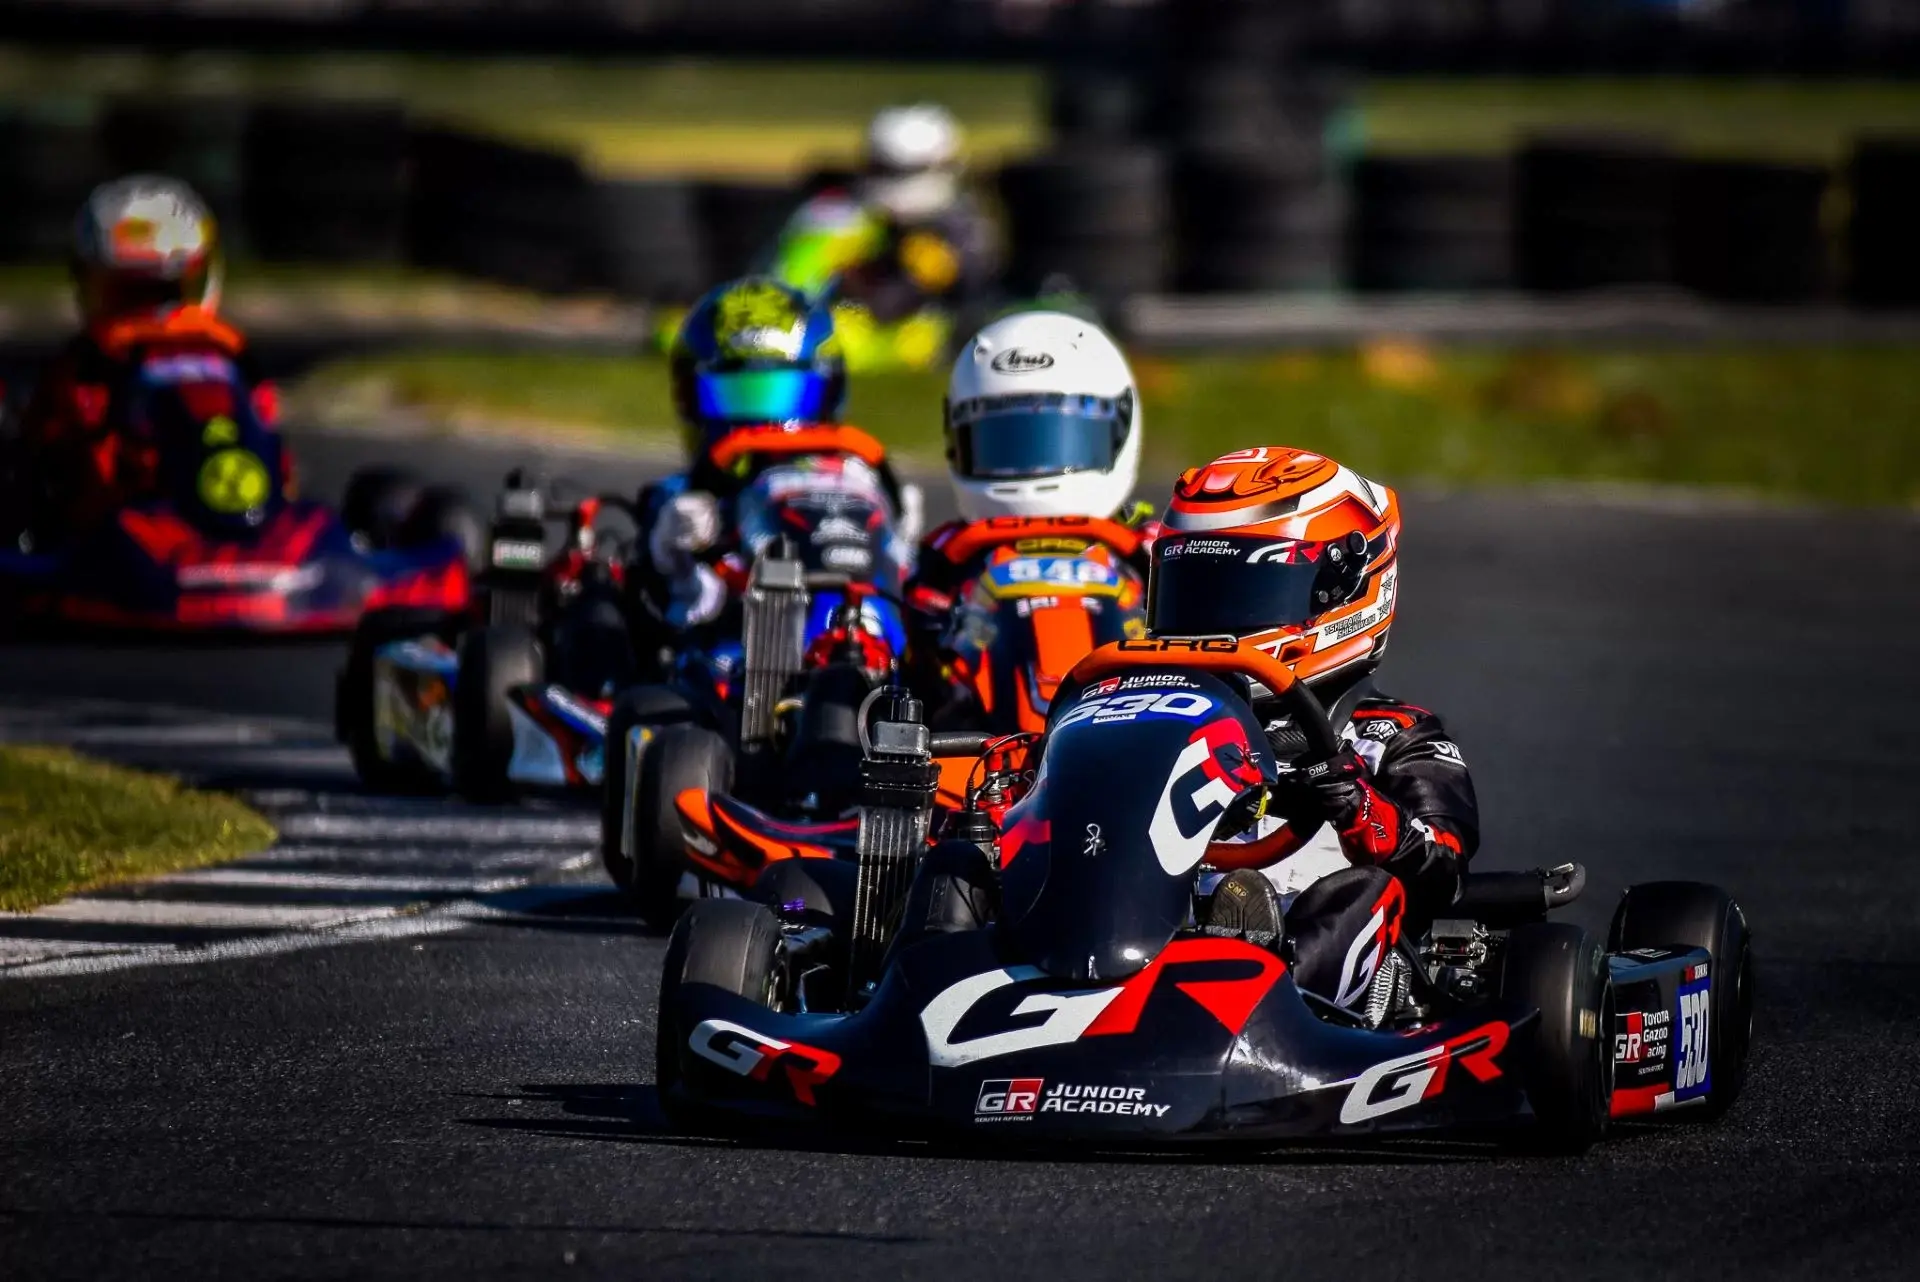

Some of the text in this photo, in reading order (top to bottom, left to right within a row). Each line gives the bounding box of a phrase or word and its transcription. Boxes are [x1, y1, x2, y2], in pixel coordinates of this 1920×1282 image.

[1164, 545, 1184, 556] GR
[1184, 547, 1240, 556] ACADEMY
[1187, 540, 1230, 548] JUNIOR
[1117, 639, 1239, 653] CRG
[1119, 681, 1201, 690] ACADEMY
[1123, 675, 1186, 686] JUNIOR
[1082, 684, 1118, 700] GR
[1366, 720, 1397, 740] OMP
[1308, 763, 1328, 776] OMP
[1227, 881, 1247, 897] OMP
[919, 937, 1287, 1067] GR
[1642, 1010, 1669, 1027] TOYOTA
[1643, 1027, 1668, 1043] GAZOO
[1676, 990, 1710, 1089] 530
[688, 1018, 842, 1107] GR
[1340, 1020, 1510, 1124] GR
[1046, 1083, 1146, 1101] JUNIOR
[979, 1092, 1036, 1111] GR
[1040, 1098, 1171, 1118] ACADEMY
